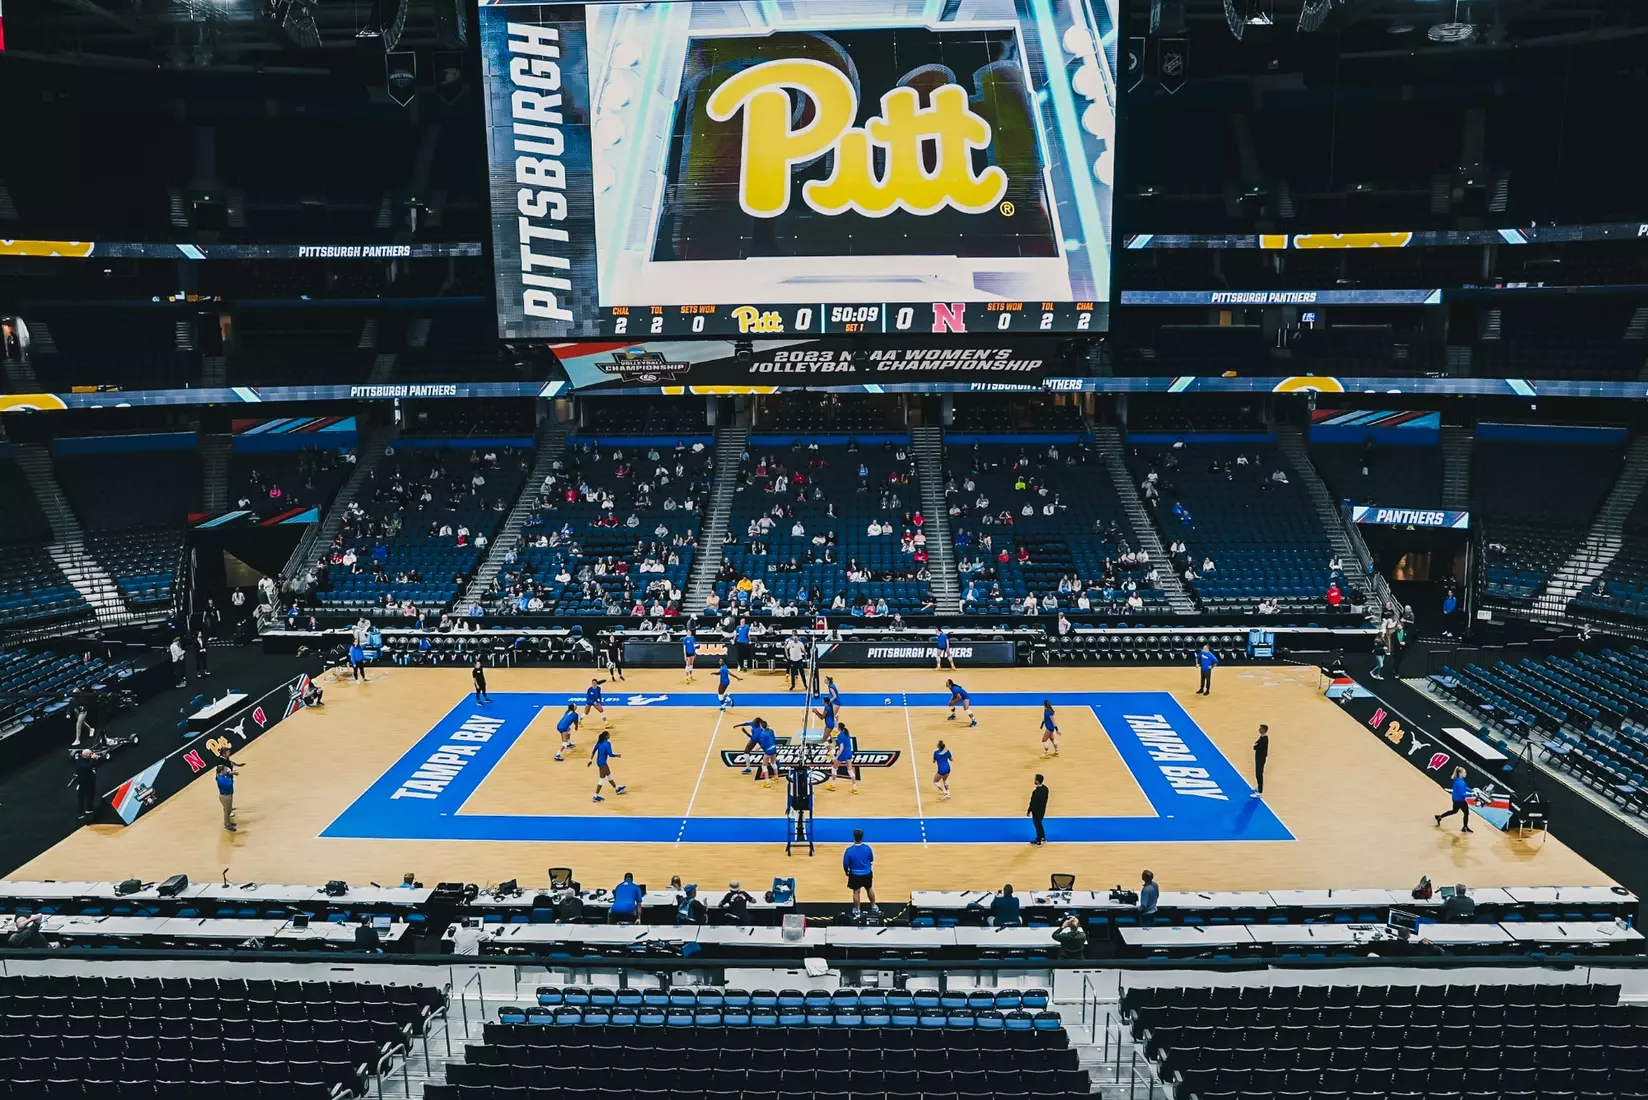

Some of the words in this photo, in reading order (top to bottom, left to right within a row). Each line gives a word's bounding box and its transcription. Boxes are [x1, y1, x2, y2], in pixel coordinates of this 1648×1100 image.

[706, 58, 1008, 218] Pitt
[507, 22, 573, 322] PITTSBURGH
[298, 246, 361, 257] PITTSBURGH
[362, 245, 411, 257] PANTHERS
[1211, 292, 1267, 303] PITTSBURGH
[1268, 292, 1317, 302] PANTHERS
[612, 306, 630, 315] CHAL
[650, 306, 664, 315] TOL
[680, 305, 698, 314] SETS
[699, 304, 716, 314] WON
[831, 306, 879, 322] 50:09
[987, 302, 1005, 311] SETS
[1005, 302, 1024, 311] WON
[1041, 302, 1054, 311] TOL
[1076, 302, 1094, 311] CHAL
[615, 317, 628, 334] 2
[650, 316, 664, 334] 2
[692, 315, 705, 332] 0
[731, 305, 785, 334] Pitt
[794, 308, 813, 331] 0
[895, 307, 915, 330] 0
[931, 302, 967, 333] N
[997, 312, 1012, 330] 0
[1039, 312, 1054, 330] 2
[1077, 312, 1092, 330] 2
[845, 323, 858, 332] SET
[859, 323, 864, 332] 1
[774, 350, 834, 362] 2023
[839, 350, 897, 361] NAA
[905, 349, 1013, 360] WOMEN'S
[877, 360, 1043, 371] CHAMPIONSHIP
[350, 386, 408, 397] PITTSBURGH
[409, 385, 457, 396] PANTHERS
[1376, 509, 1445, 525] PANTHERS
[867, 647, 924, 658] PITTSBURGH
[1368, 708, 1388, 729] N
[1123, 714, 1198, 761] TAMPA
[183, 749, 207, 773] N
[390, 745, 482, 800] TAMPA
[449, 714, 505, 742] BAY
[1158, 766, 1229, 800] BAY
